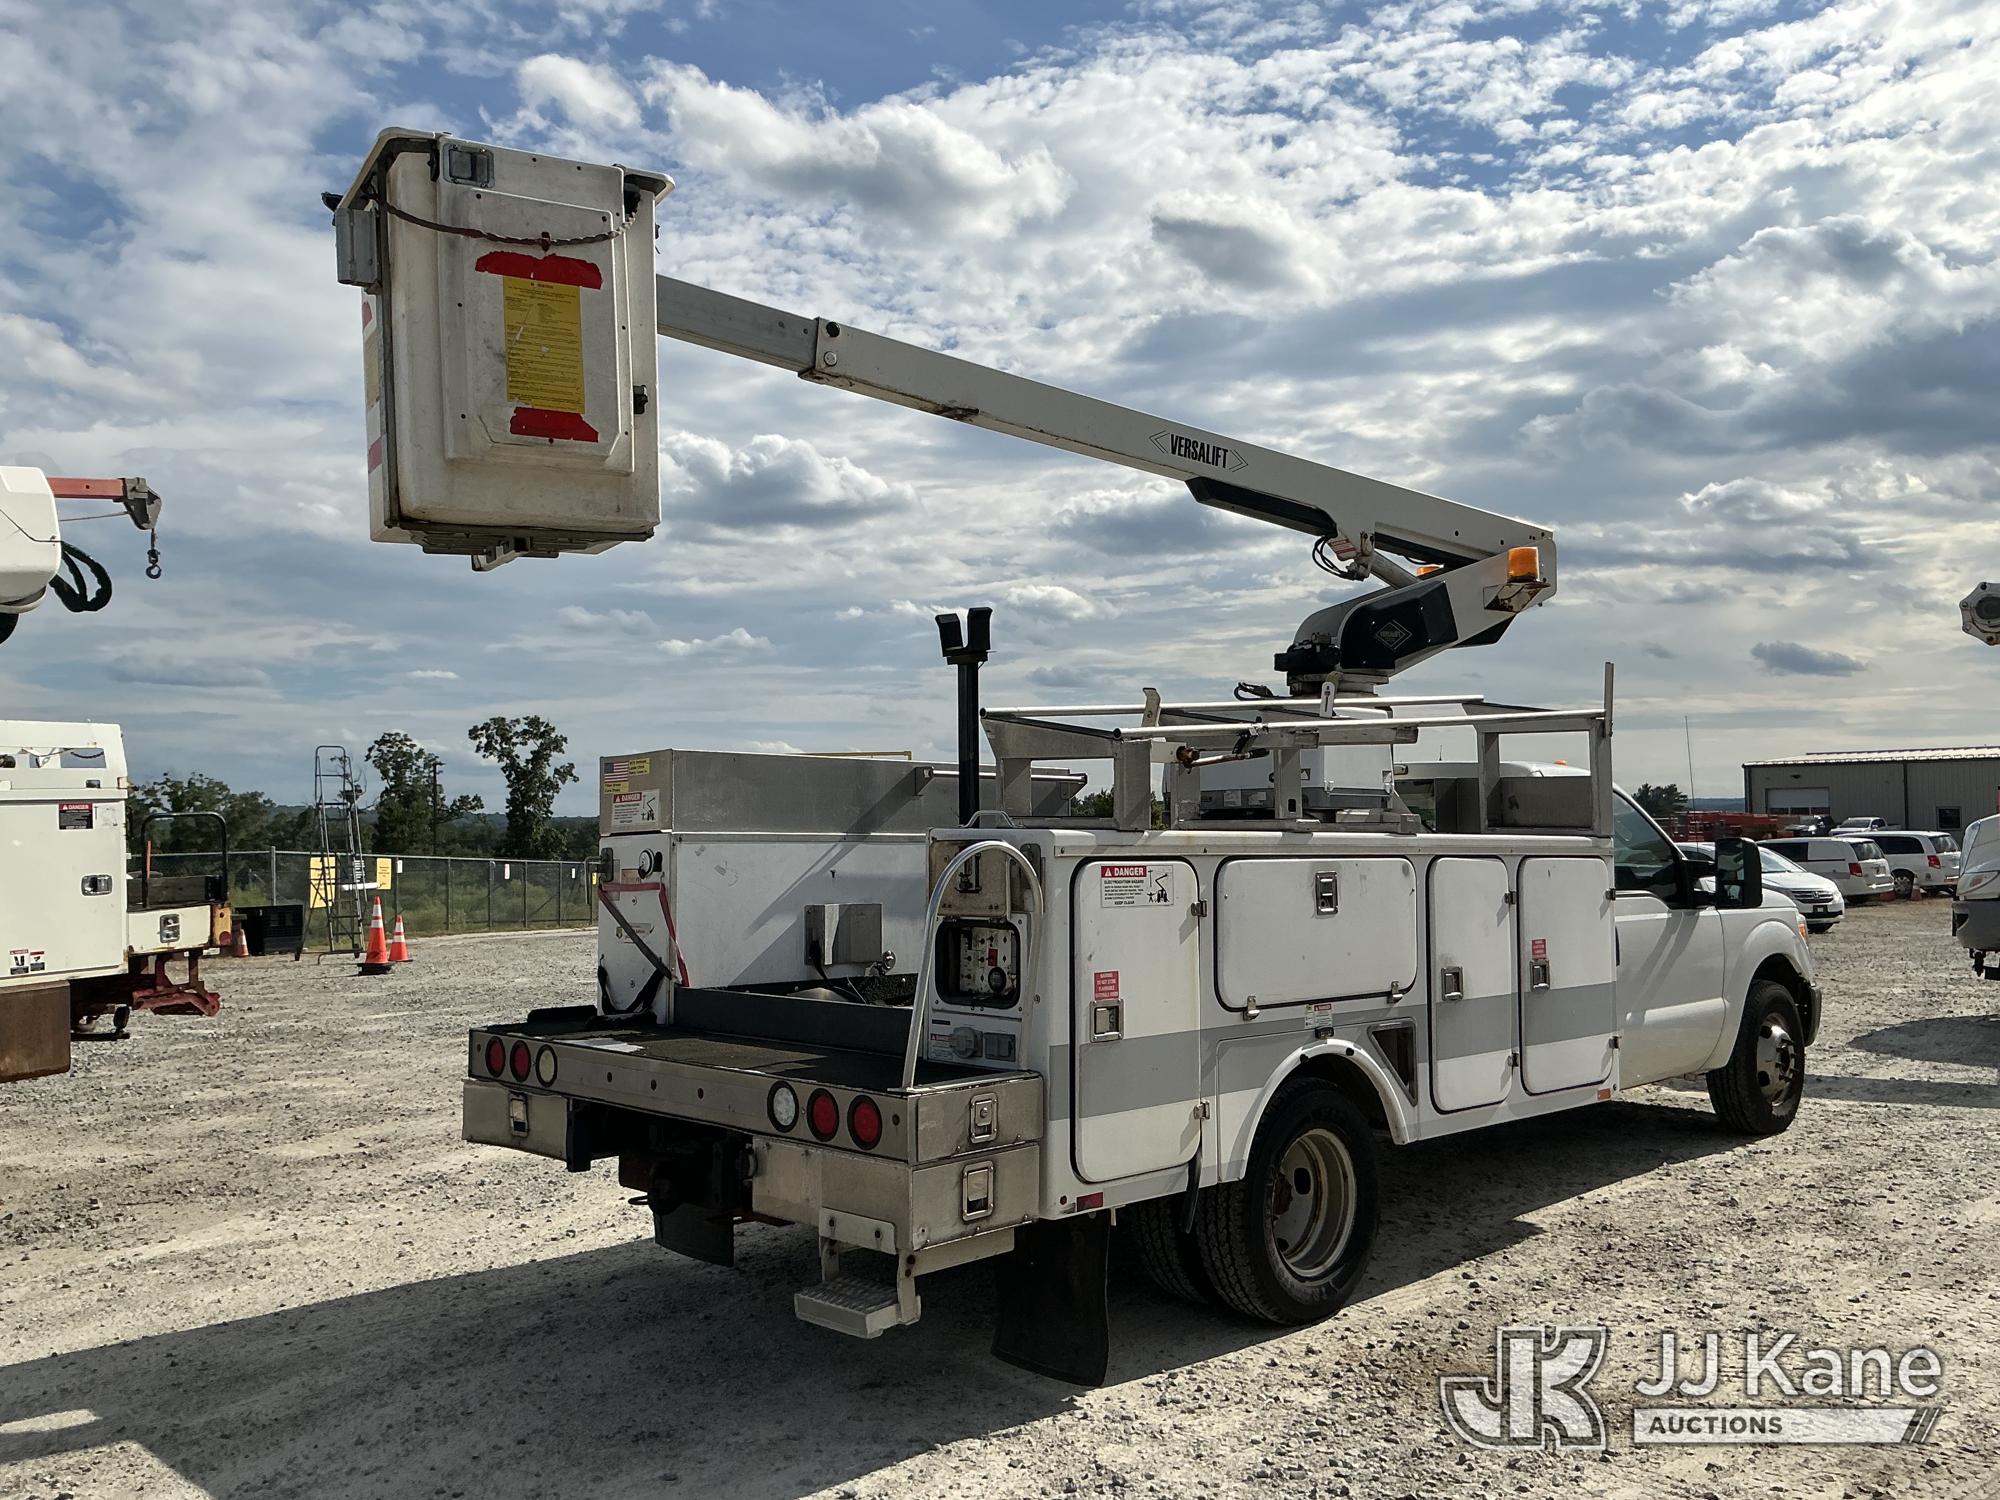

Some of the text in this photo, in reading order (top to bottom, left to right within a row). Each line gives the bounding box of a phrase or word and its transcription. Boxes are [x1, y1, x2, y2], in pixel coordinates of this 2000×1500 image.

[1170, 434, 1228, 468] VERSALIFT
[621, 793, 640, 802] DANGER
[1114, 867, 1144, 877] DANGER
